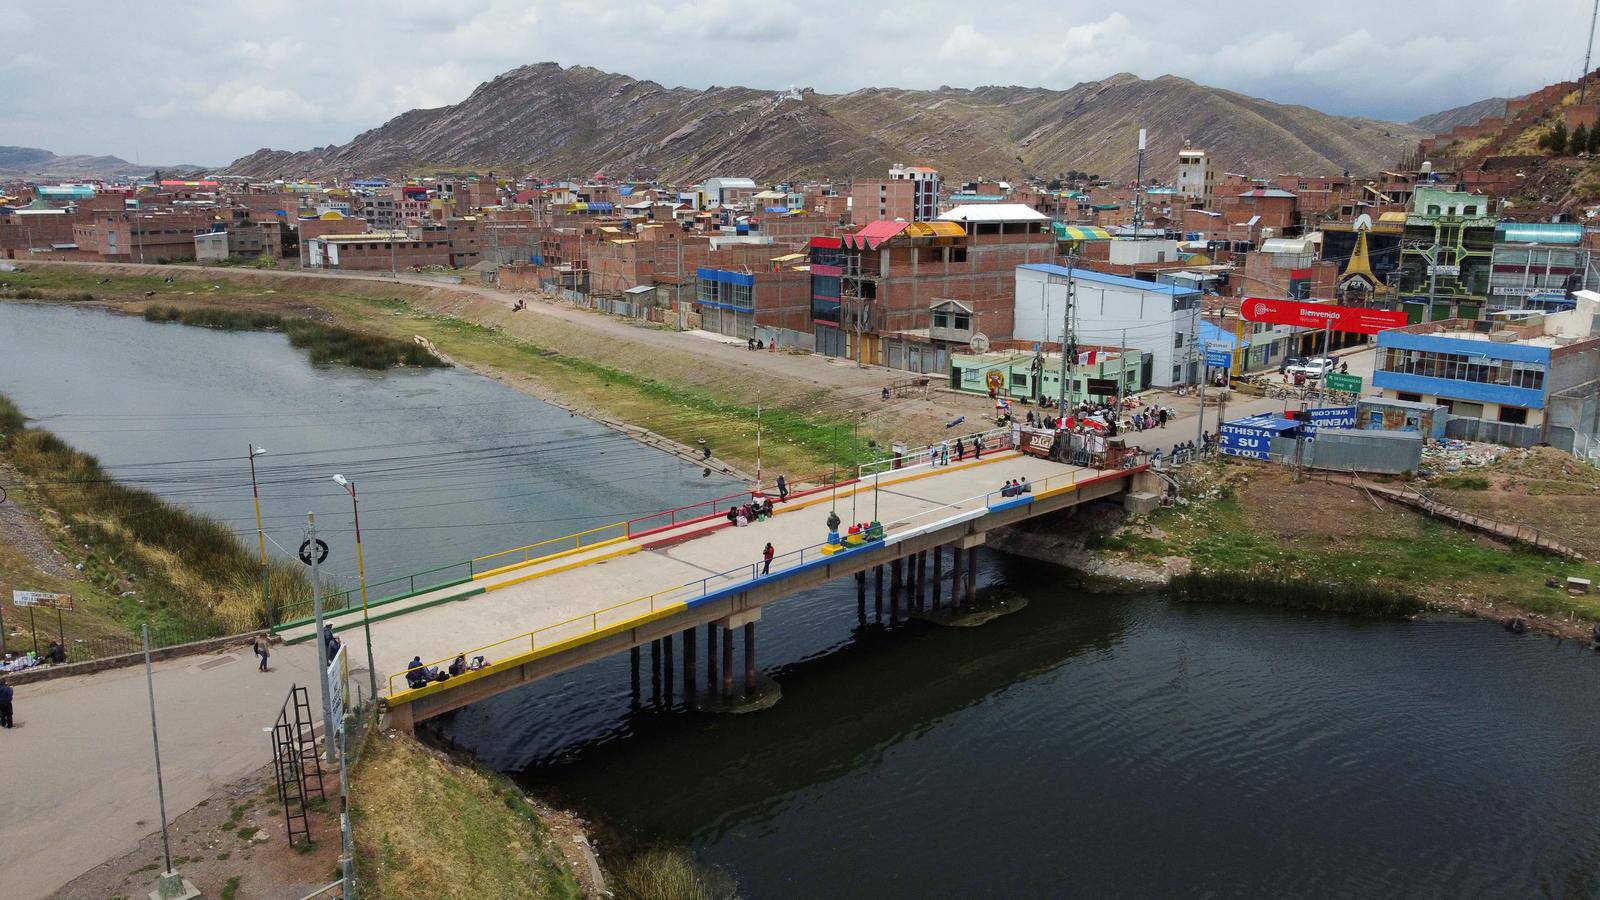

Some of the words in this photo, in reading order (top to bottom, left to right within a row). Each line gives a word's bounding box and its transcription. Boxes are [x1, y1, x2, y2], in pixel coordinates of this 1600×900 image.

[1300, 308, 1341, 319] Bienvenido
[1238, 437, 1259, 448] SU
[1234, 448, 1259, 458] YOU
